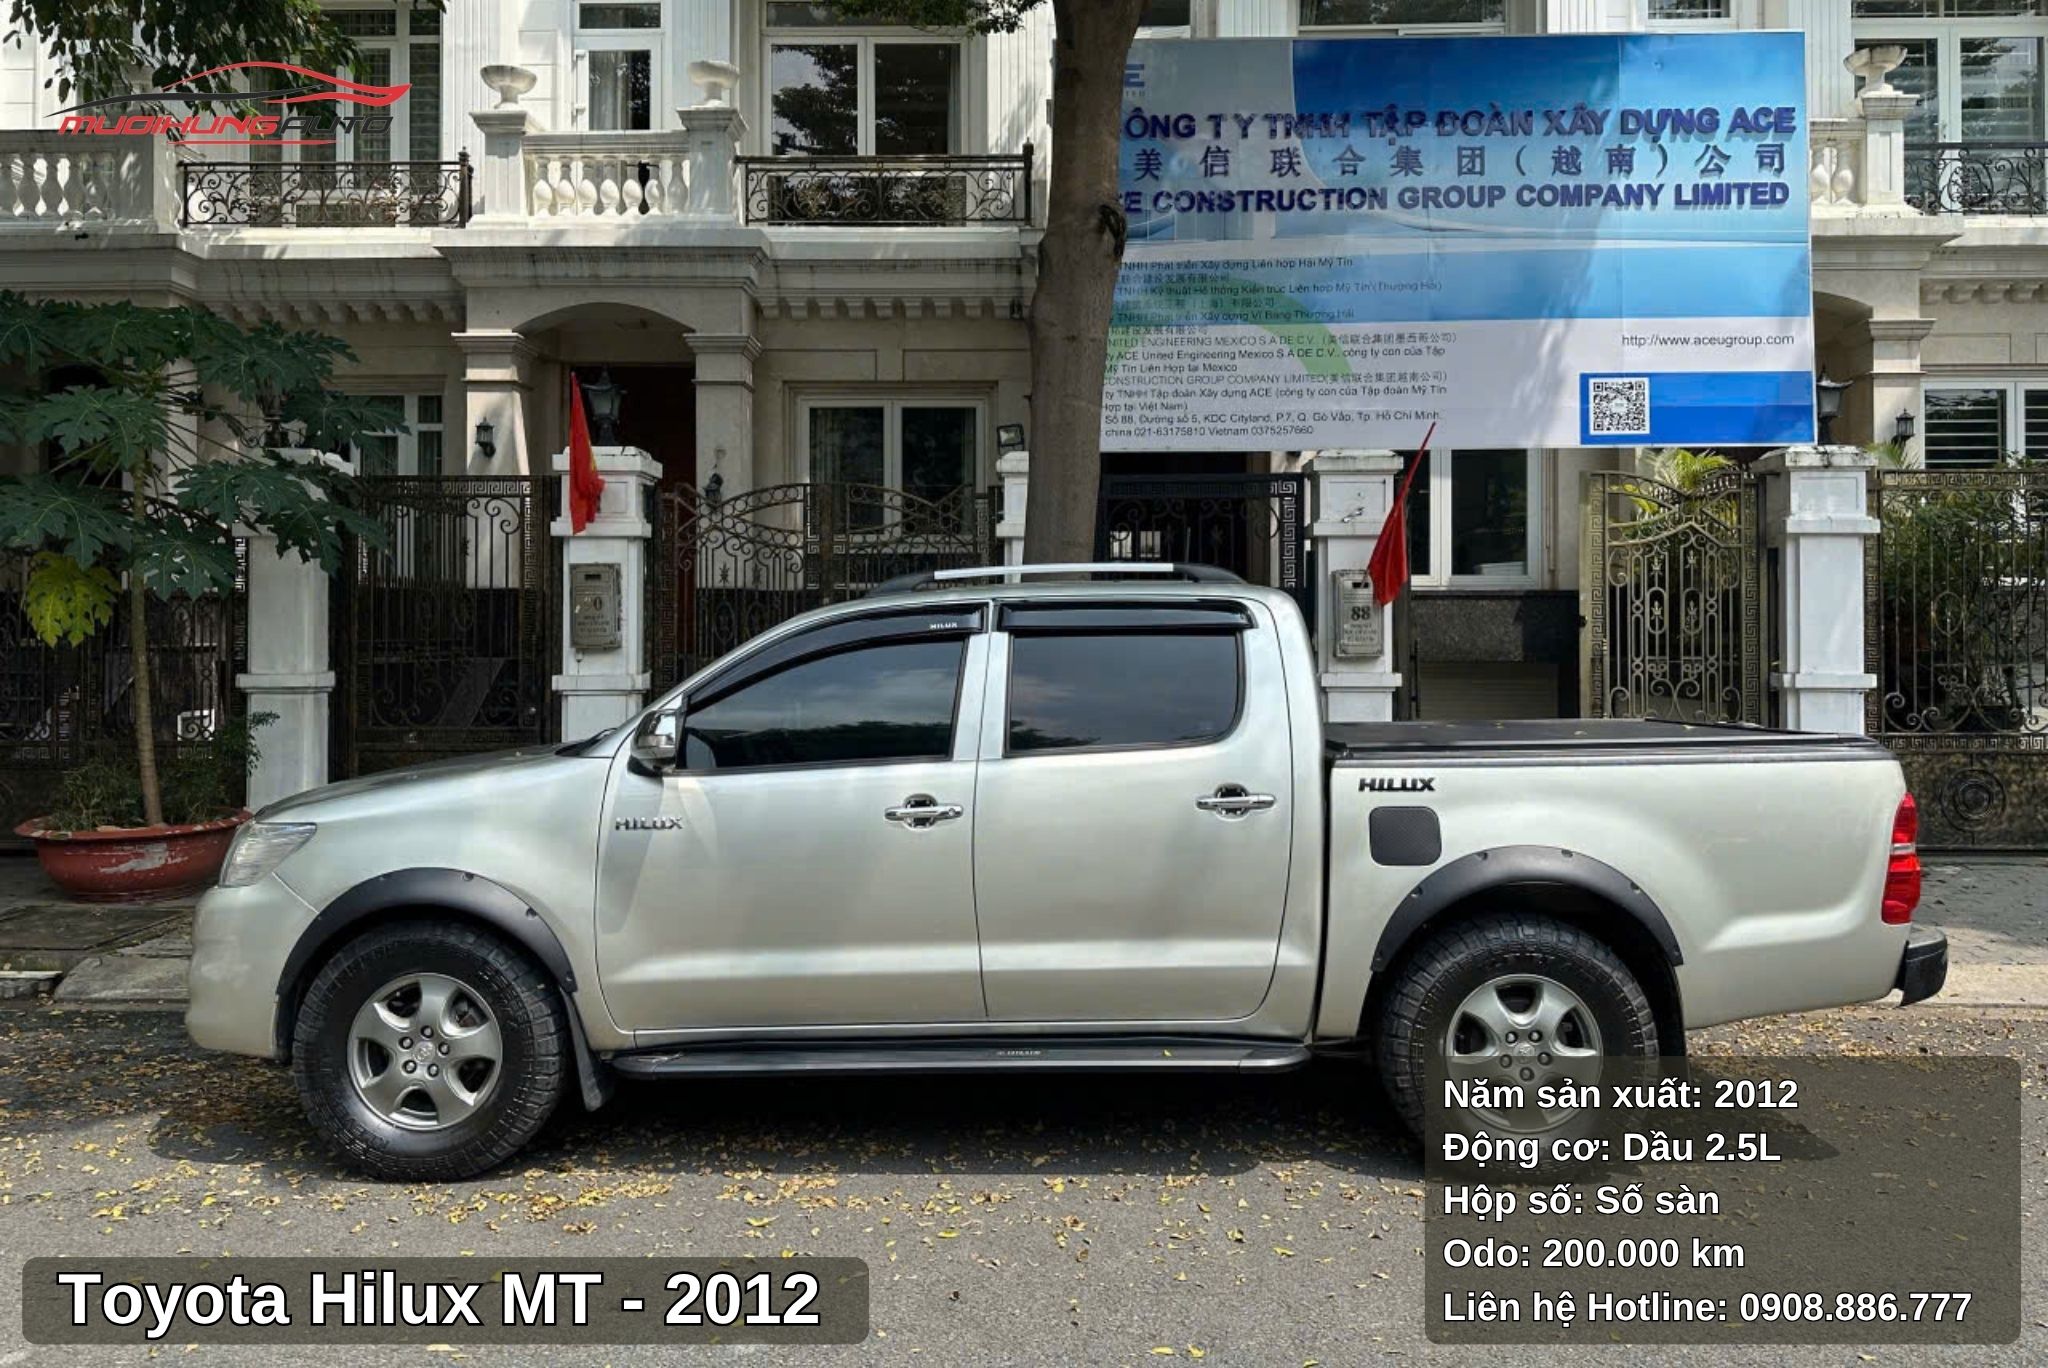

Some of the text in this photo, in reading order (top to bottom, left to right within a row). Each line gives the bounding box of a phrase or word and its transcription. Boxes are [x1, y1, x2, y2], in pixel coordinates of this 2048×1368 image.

[1120, 106, 1196, 139] ÔNG
[1264, 112, 1350, 139] TNHH
[1364, 103, 1427, 146] TẬP
[1436, 103, 1534, 137] ĐOÀN
[1542, 103, 1611, 137] XÂY
[1620, 108, 1720, 144] DỰNG
[1728, 107, 1796, 135] ACE
[1153, 185, 1388, 213] CONSTRUCTION
[1398, 184, 1506, 210] GROUP
[1516, 182, 1664, 208] COMPANY
[1674, 182, 1789, 206] LIMITED
[1215, 335, 1256, 346] MEXICO
[1621, 333, 1795, 348] http://www.aceugroup.com
[1202, 363, 1237, 373] Mexico
[1187, 375, 1225, 386] GROUP
[1227, 375, 1280, 385] COMPANY
[1249, 387, 1272, 397] ACE
[1203, 413, 1226, 423] KDC
[1105, 428, 1132, 437] china
[1208, 426, 1248, 436] Vietnam
[1351, 606, 1370, 621] 88
[929, 621, 958, 630] HILUX
[1358, 777, 1436, 792] HILUX
[615, 816, 683, 831] HILUX
